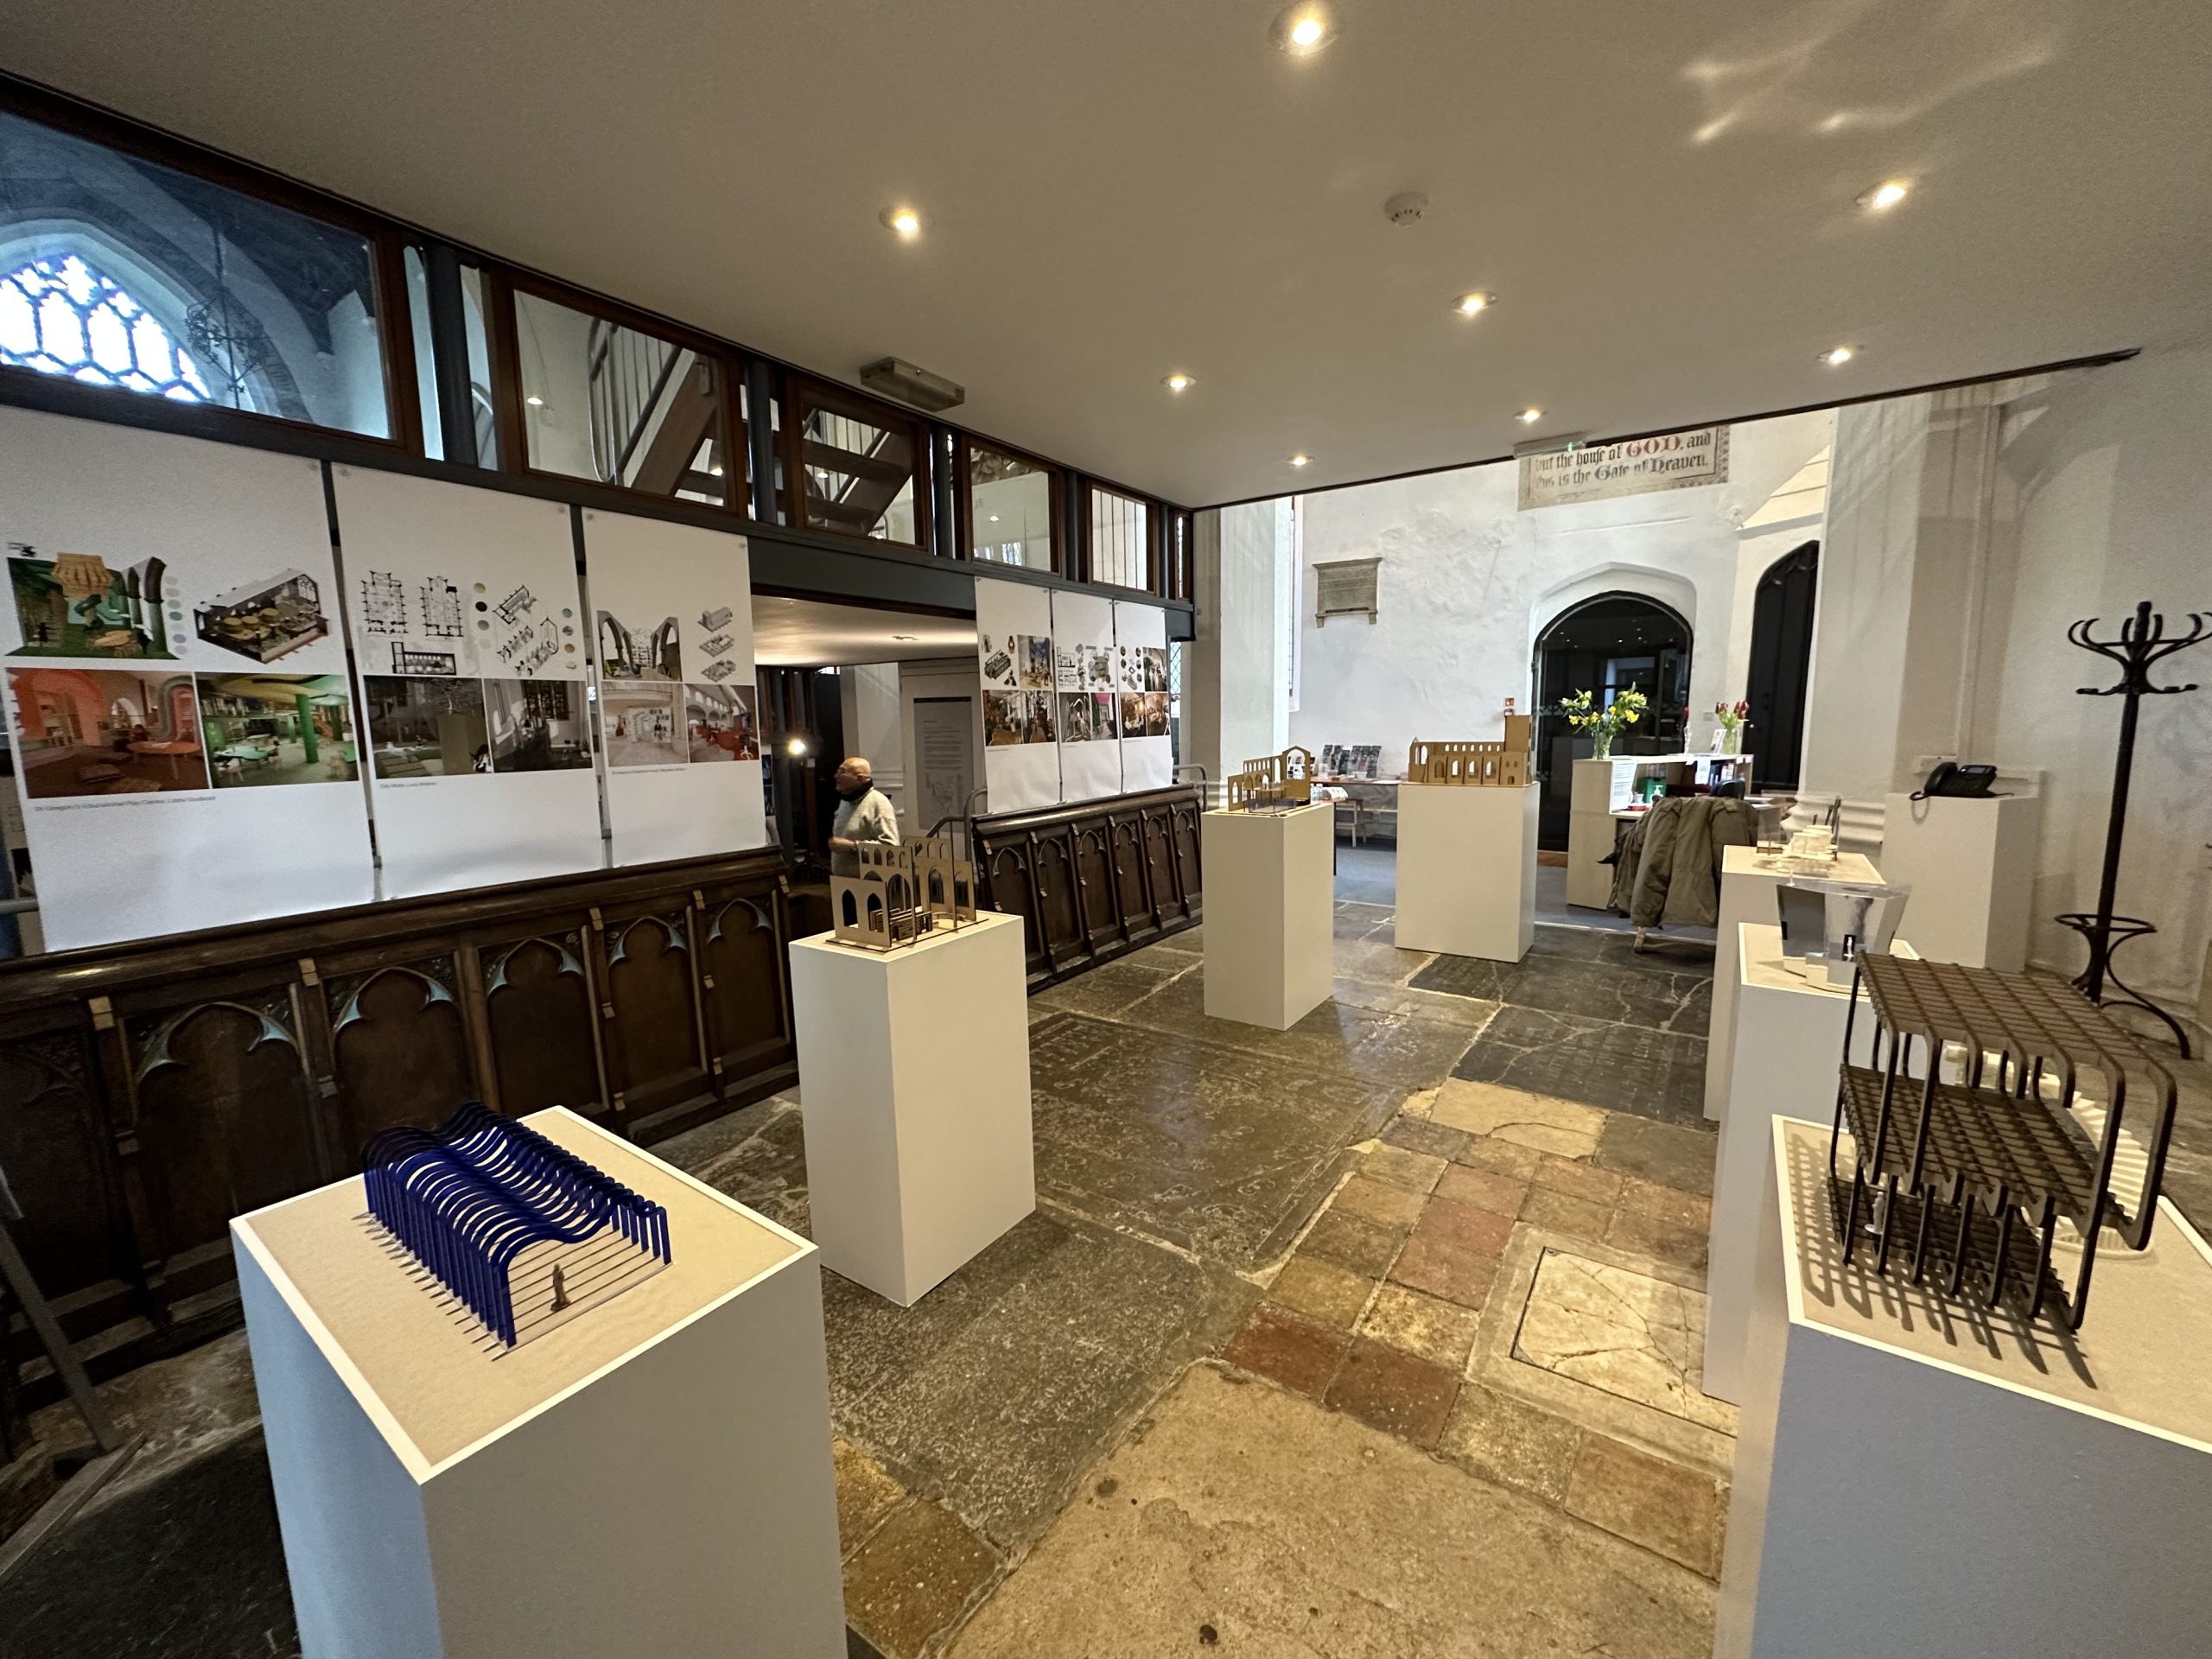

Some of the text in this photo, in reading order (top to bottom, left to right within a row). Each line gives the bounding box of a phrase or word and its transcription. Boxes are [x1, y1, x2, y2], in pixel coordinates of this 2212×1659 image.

[1556, 453, 1573, 470] the
[1609, 442, 1624, 461] of
[1687, 430, 1711, 448] and
[1559, 474, 1570, 486] is
[1573, 468, 1591, 486] the
[1594, 464, 1629, 480] Gate
